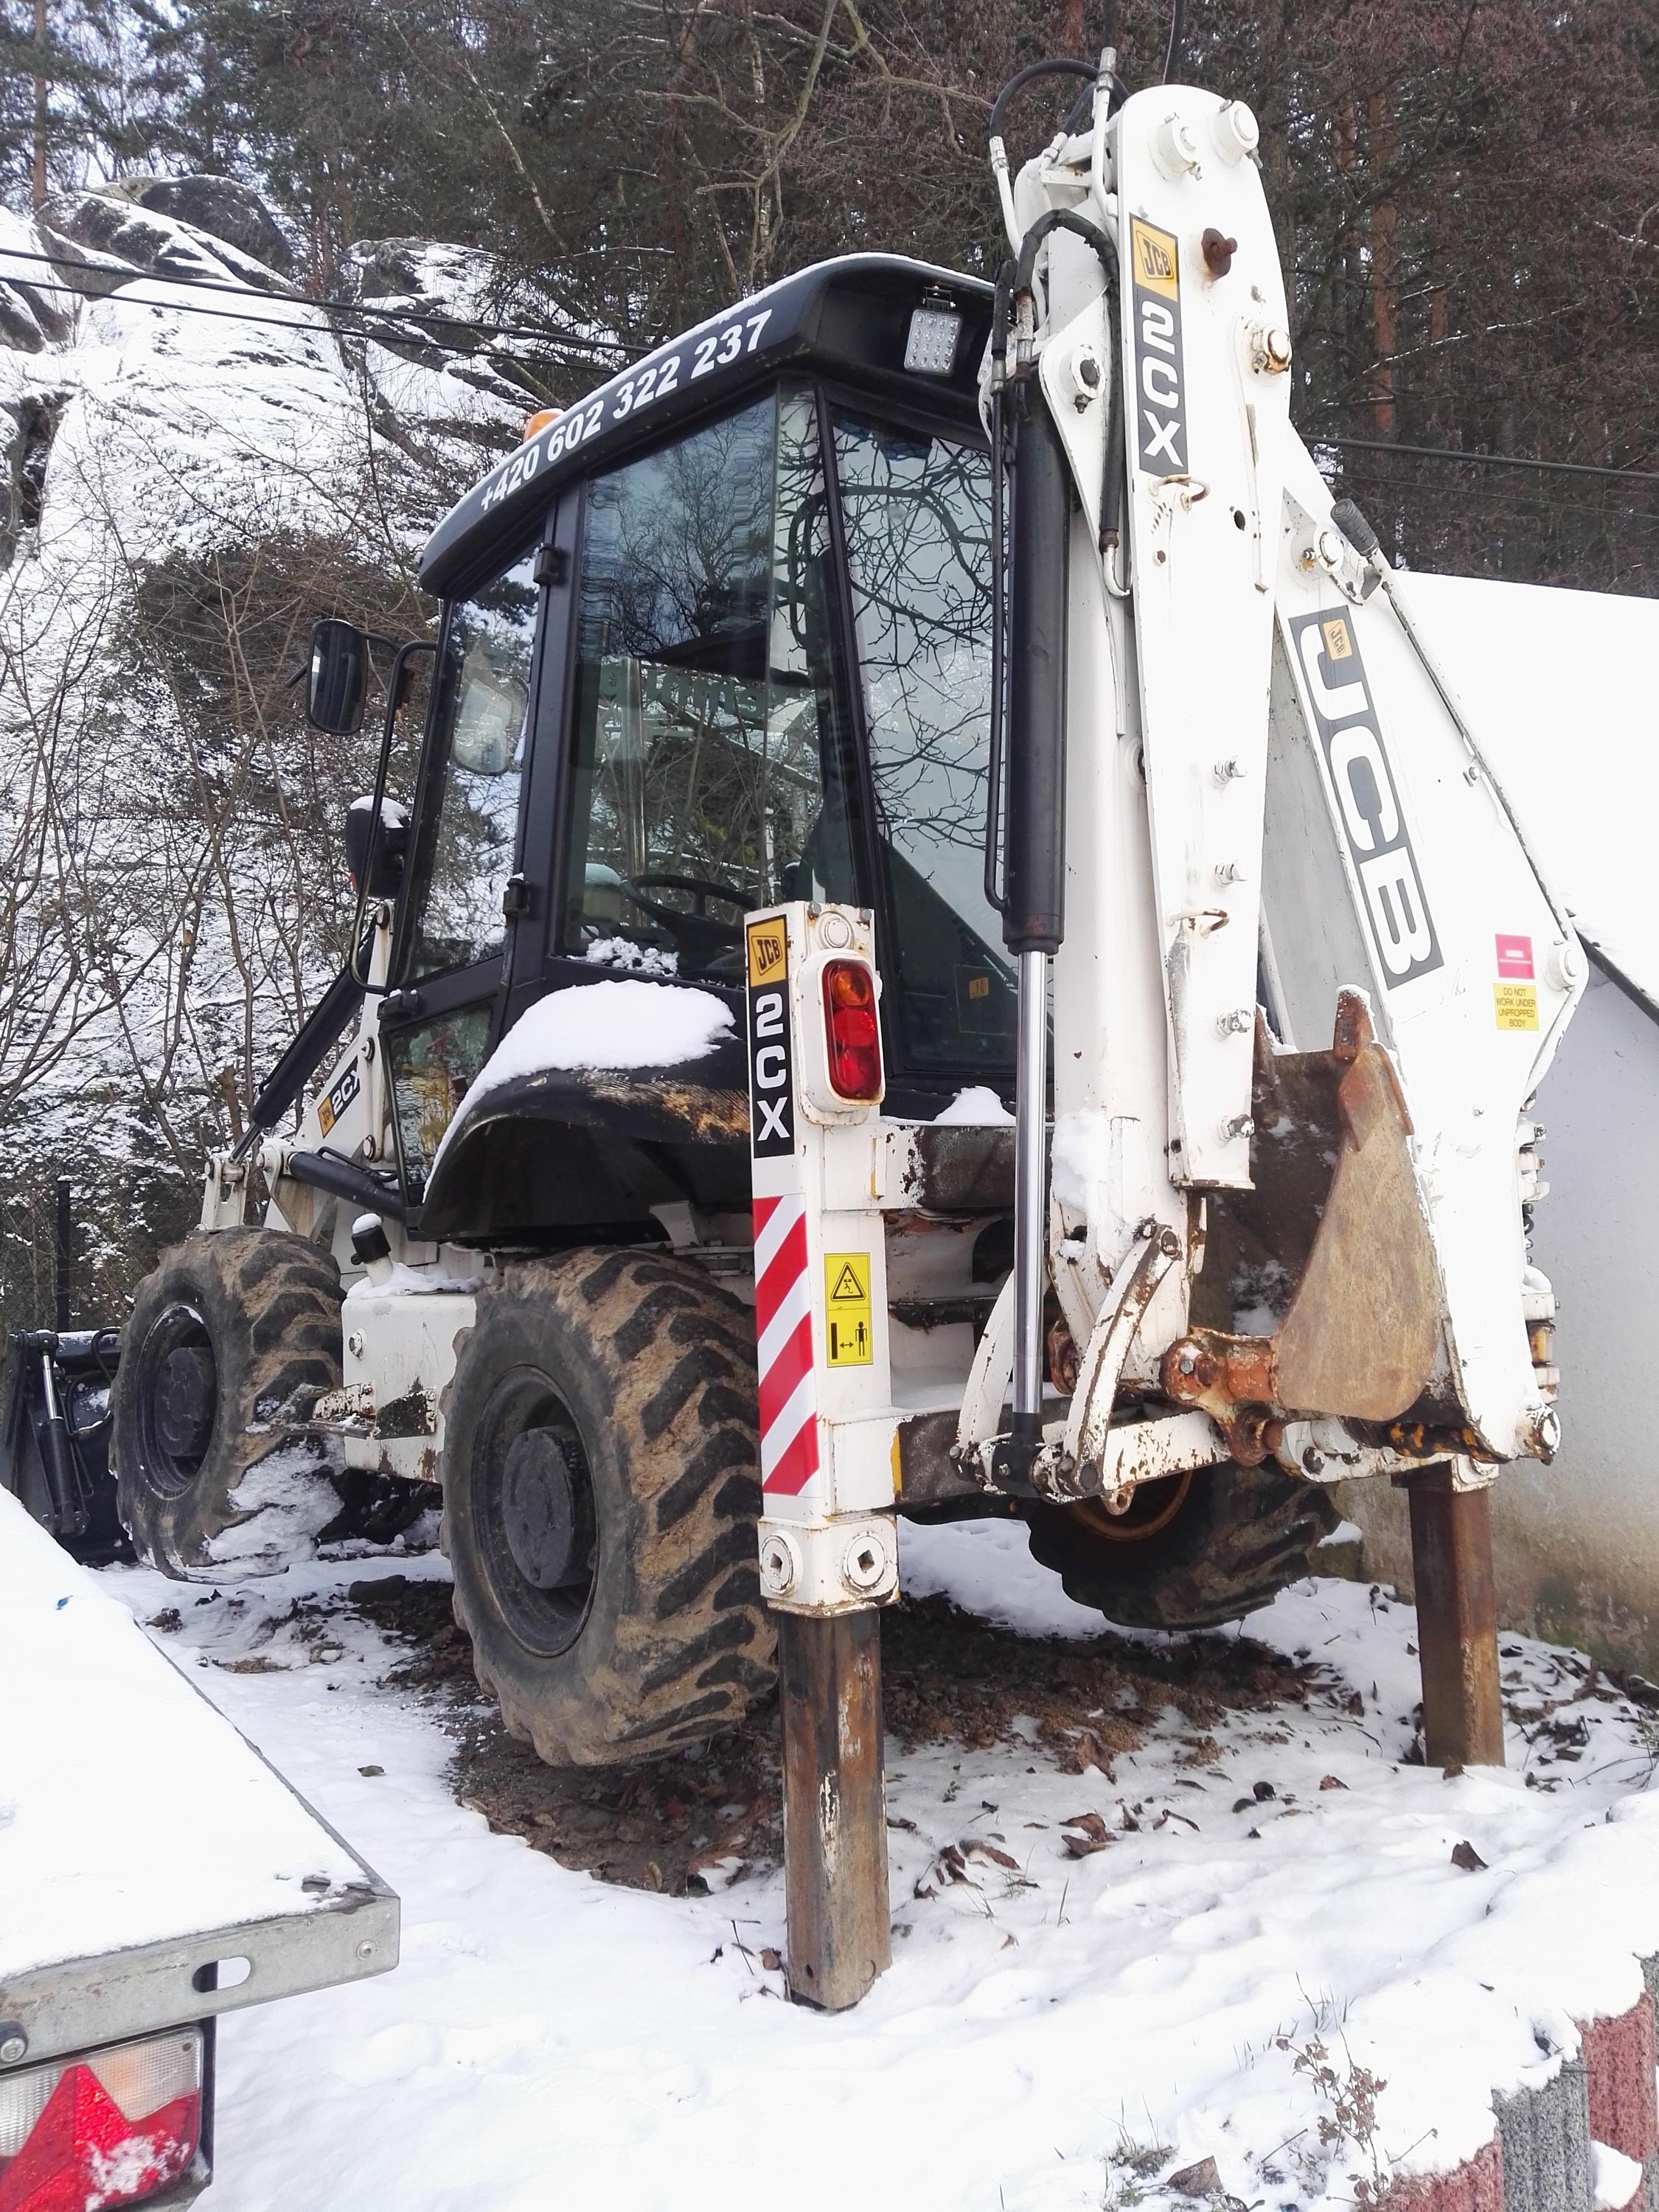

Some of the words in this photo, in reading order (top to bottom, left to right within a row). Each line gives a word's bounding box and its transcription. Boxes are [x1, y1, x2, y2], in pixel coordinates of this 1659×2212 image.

[1144, 236, 1172, 277] JCB
[1141, 300, 1185, 468] 2CX
[481, 444, 540, 512] +420
[547, 400, 604, 462] 602
[613, 355, 681, 420] 322
[690, 308, 773, 380] 237
[1330, 627, 1345, 653] JCB
[1299, 622, 1434, 976] JCB
[757, 936, 782, 971] JCB
[1496, 998, 1514, 1006] WORK
[1516, 999, 1536, 1007] UNDER
[1503, 987, 1512, 995] DO
[1514, 988, 1526, 996] NOT
[1498, 1009, 1535, 1018] UNPROPPED
[1509, 1019, 1526, 1027] BODY
[756, 992, 790, 1141] 2CX
[332, 1070, 361, 1116] 2CX
